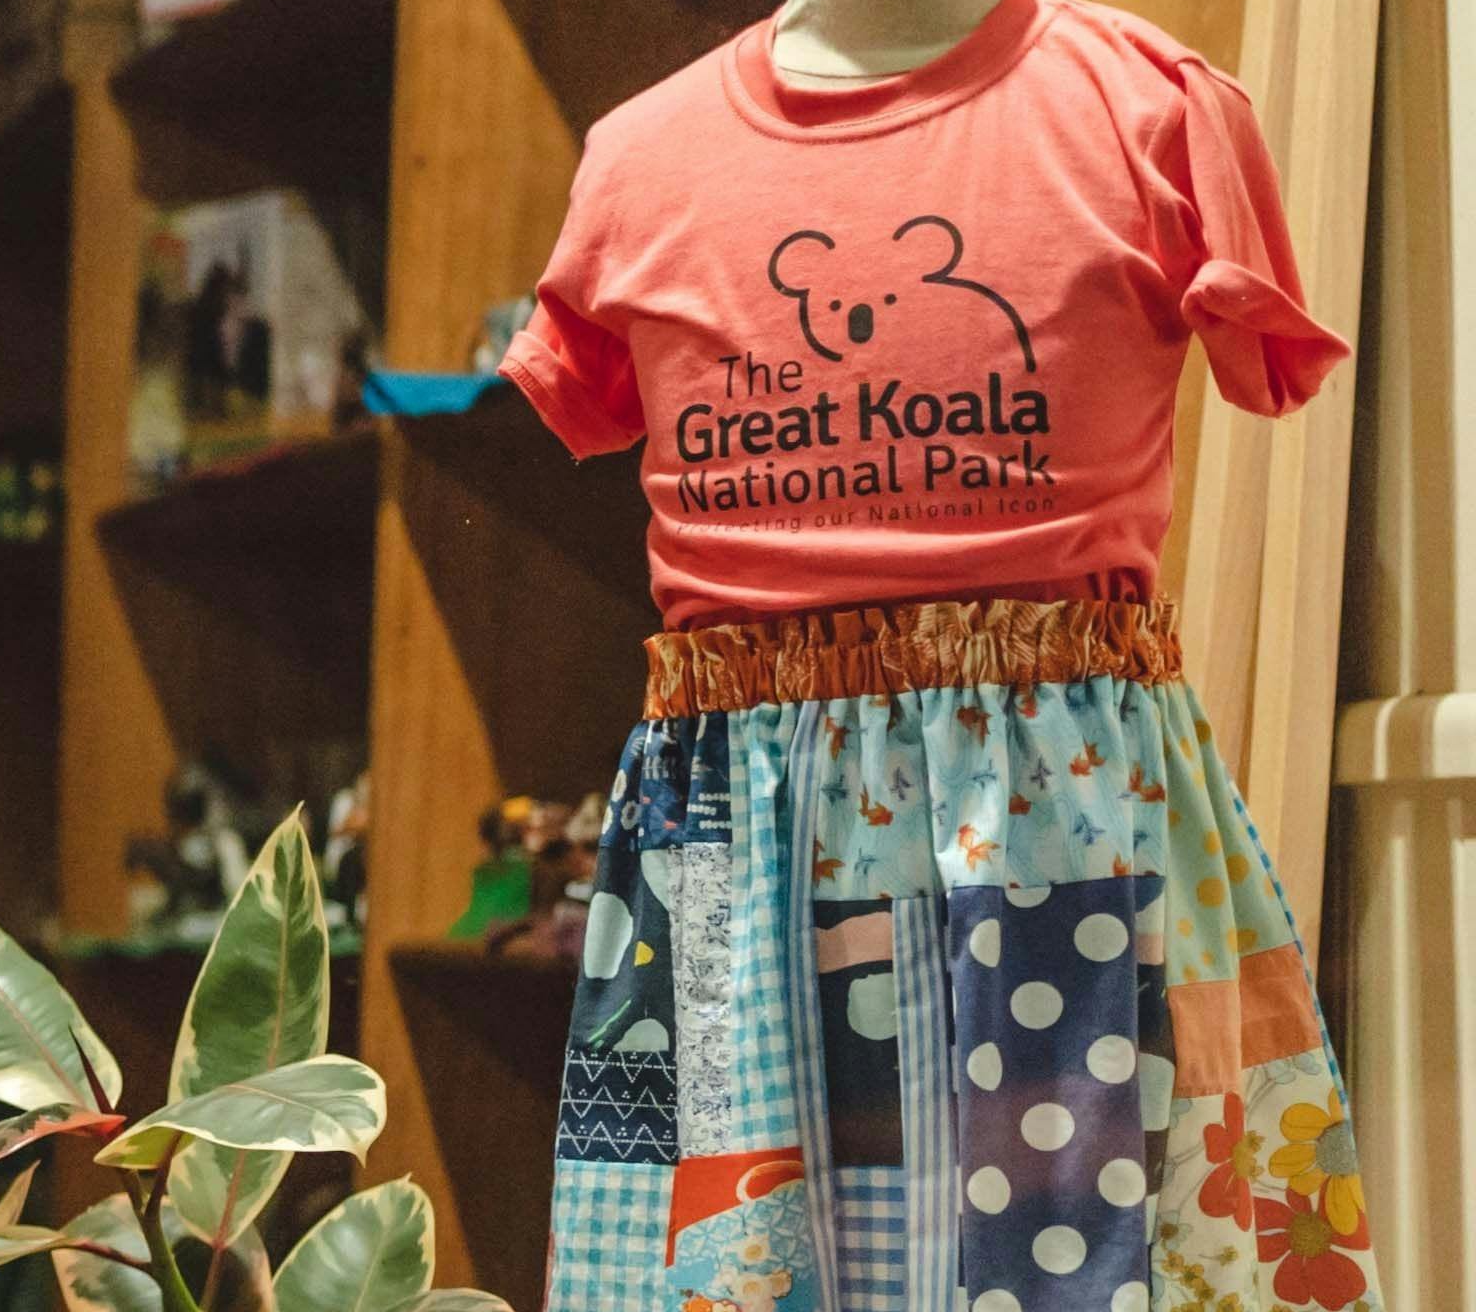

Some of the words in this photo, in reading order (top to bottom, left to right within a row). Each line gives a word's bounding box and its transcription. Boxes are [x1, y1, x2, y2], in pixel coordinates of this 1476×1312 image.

[719, 351, 803, 399] The
[675, 395, 839, 465] Great
[858, 372, 1051, 442] Koala
[677, 448, 902, 515] National
[924, 441, 1056, 493] Park
[814, 510, 857, 528] our
[869, 499, 984, 521] National
[997, 496, 1055, 515] Icon
